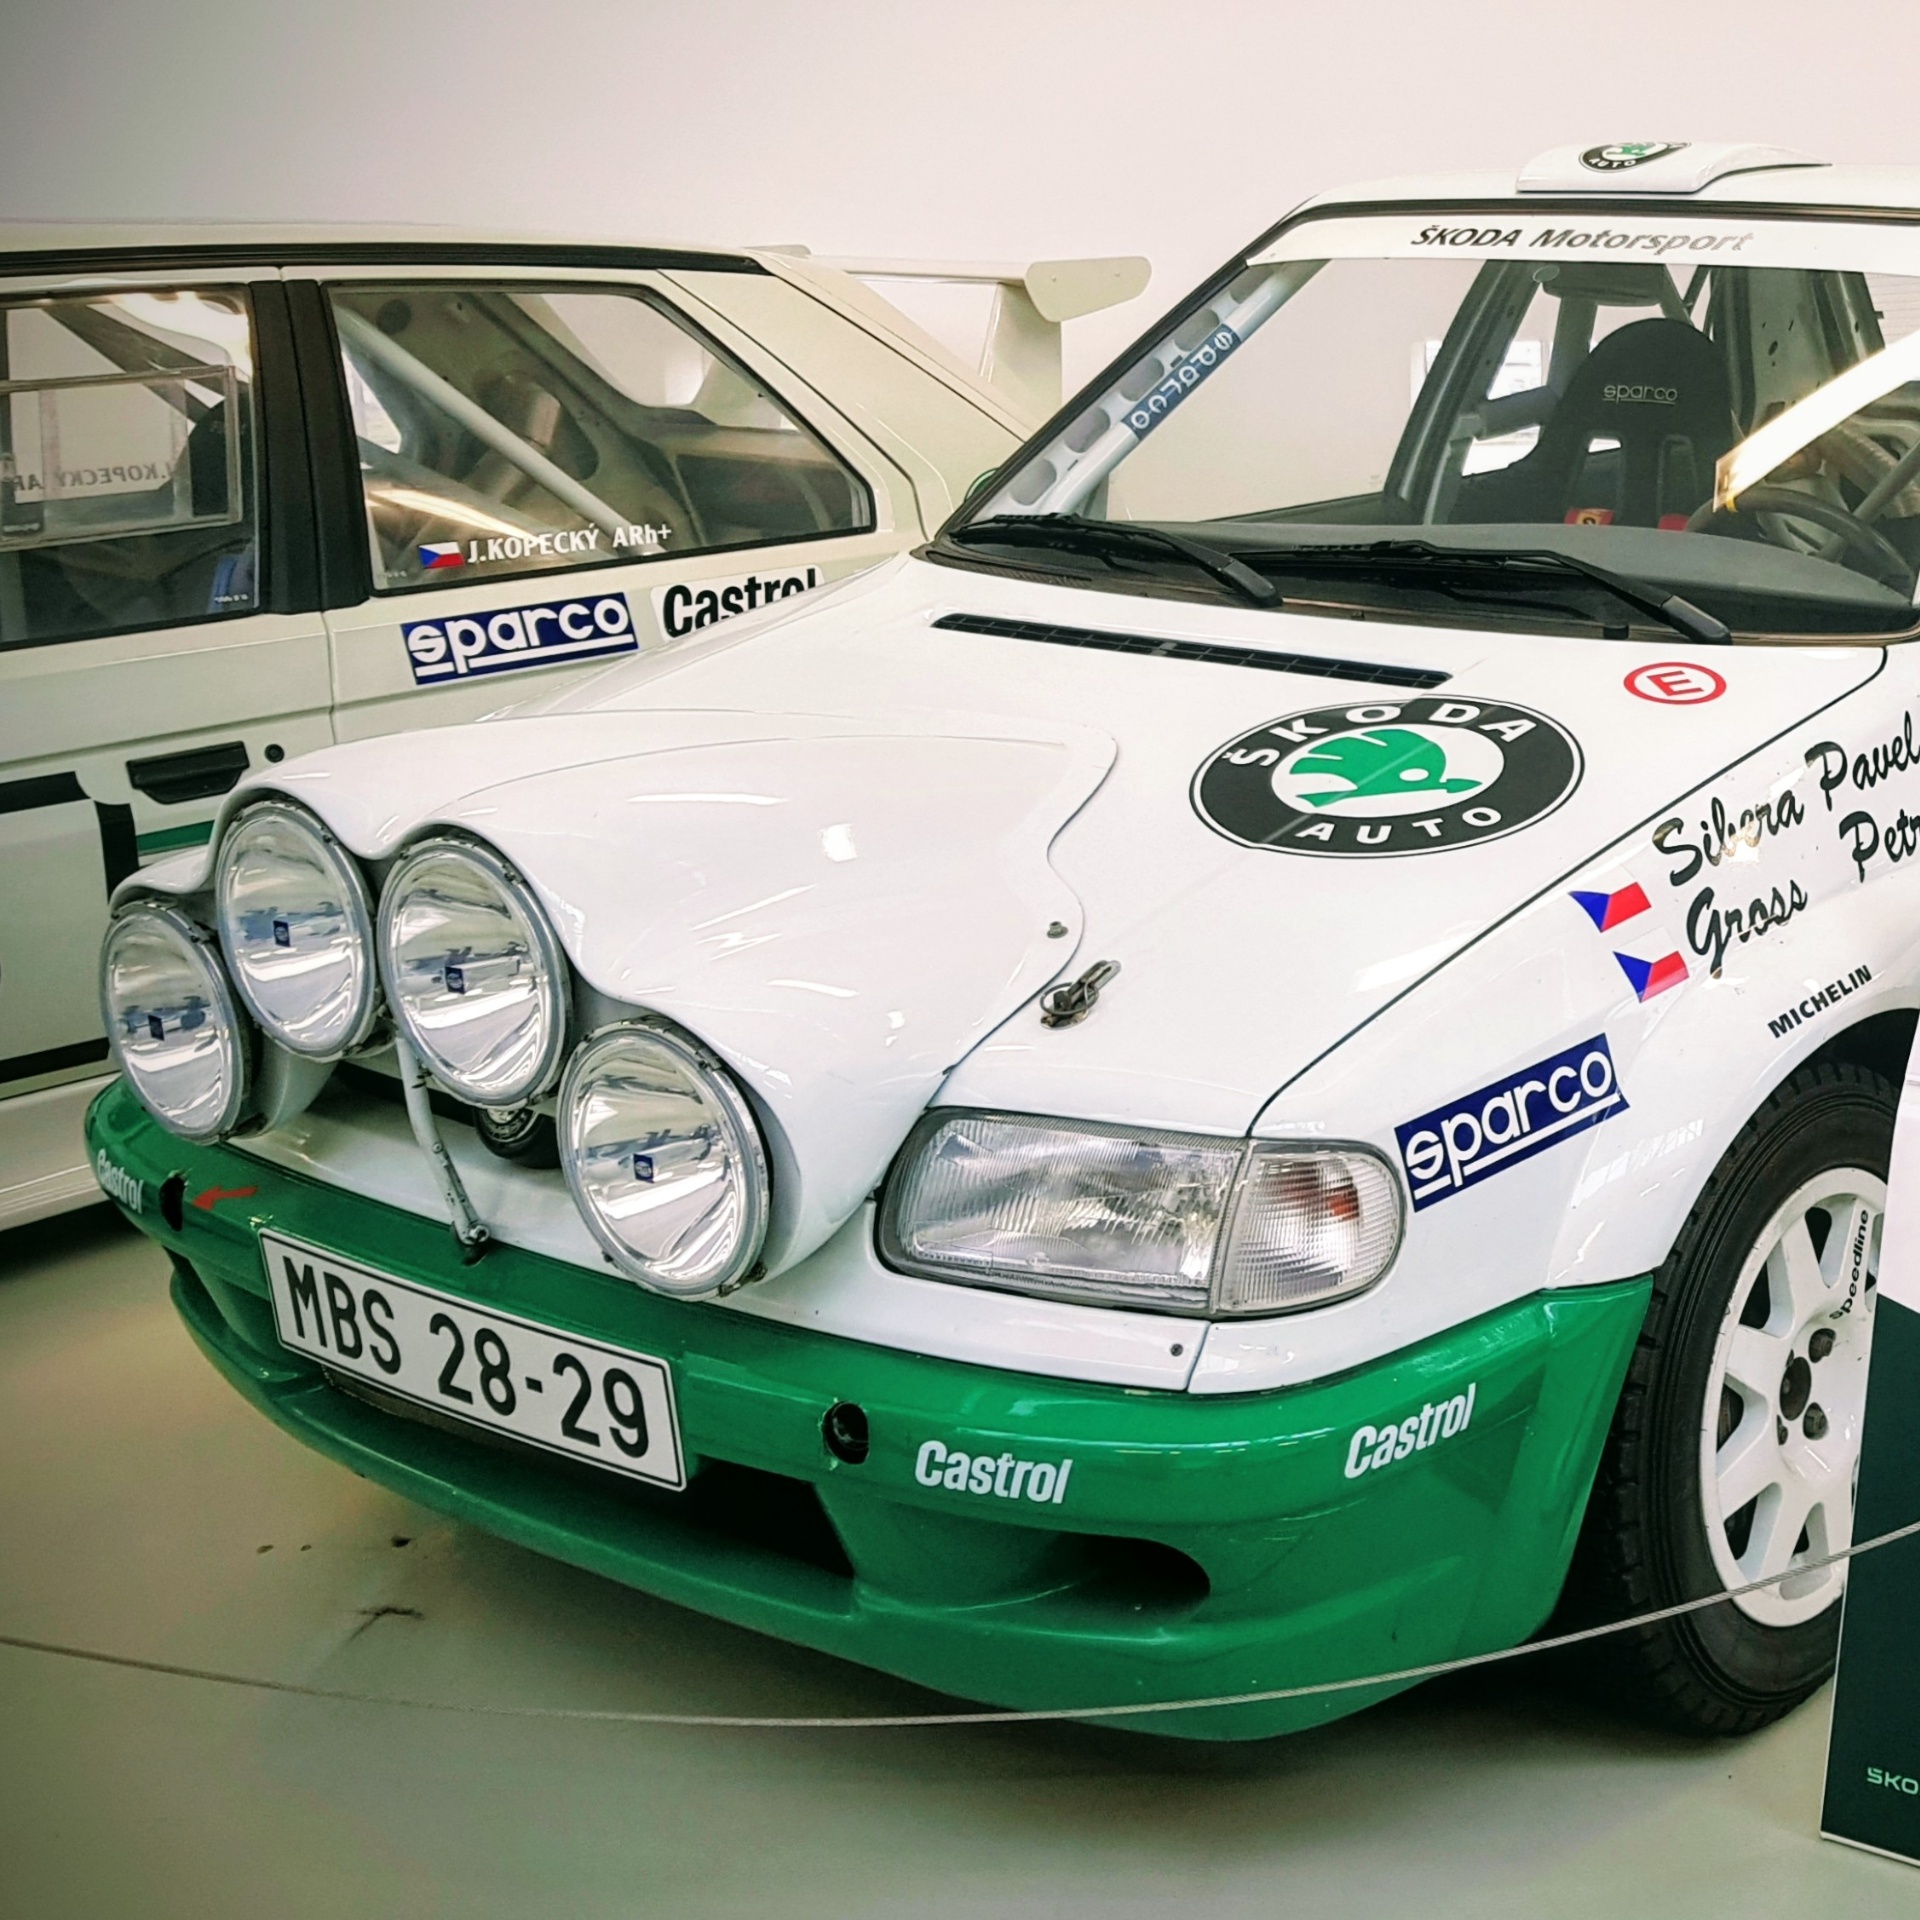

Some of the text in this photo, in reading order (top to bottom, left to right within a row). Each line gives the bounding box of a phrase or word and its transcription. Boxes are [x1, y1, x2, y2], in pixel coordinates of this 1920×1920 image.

[1588, 158, 1637, 168] AUTO
[1411, 224, 1755, 257] ŠKODA Motorsport
[1130, 331, 1233, 430] sparco
[1603, 384, 1678, 405] sparco
[467, 523, 673, 564] J.KOPECKÝ ARh+
[407, 598, 635, 677] sparco
[1221, 704, 1538, 768] ŠKODA
[1804, 710, 1920, 812] Pavel
[1295, 806, 1502, 845] AUTO
[1686, 879, 1808, 980] Gross
[1767, 964, 1874, 1039] MICHELIN
[1405, 1050, 1620, 1200] sparco
[97, 1148, 145, 1215] Castrol
[282, 1255, 650, 1459] MBS 28-29
[1343, 1381, 1477, 1479] Castrol
[914, 1439, 1074, 1505] Castrol
